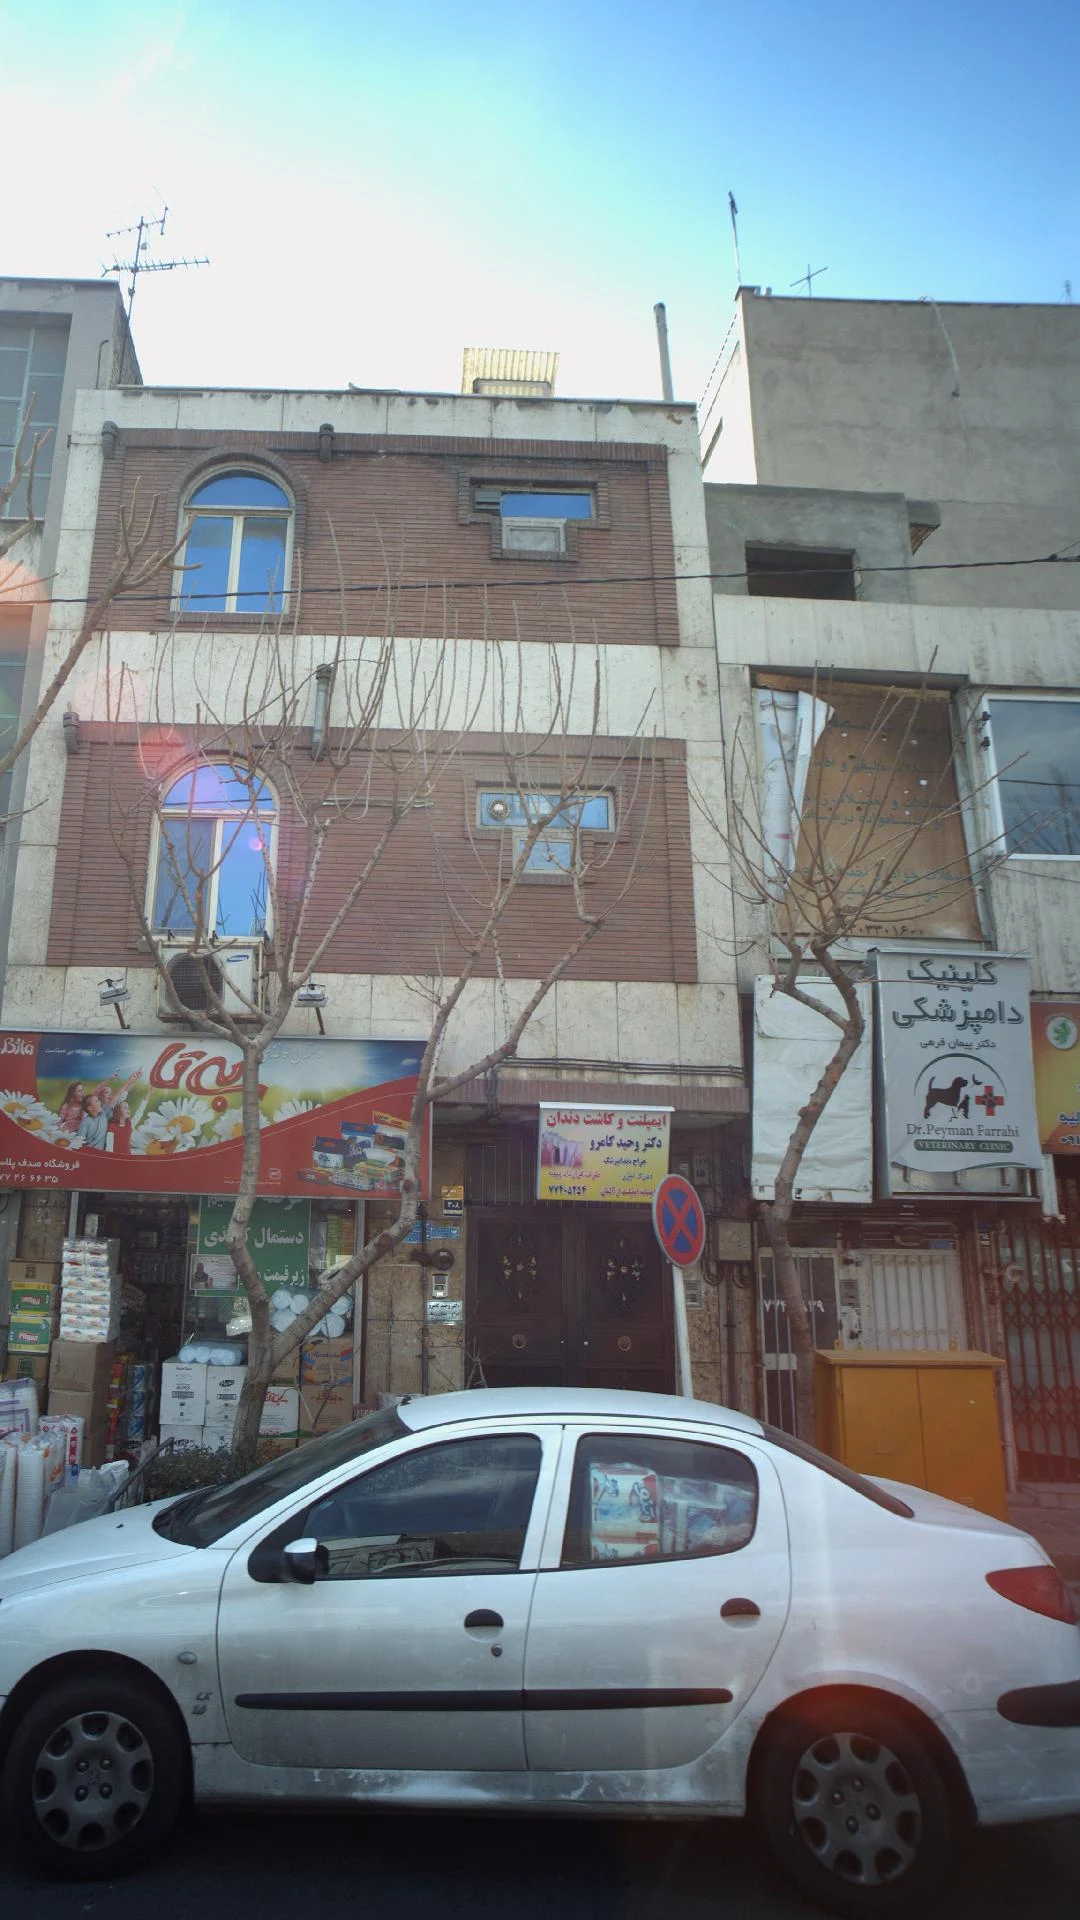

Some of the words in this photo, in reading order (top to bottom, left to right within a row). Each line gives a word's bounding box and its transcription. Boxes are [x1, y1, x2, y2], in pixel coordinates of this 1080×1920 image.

[907, 959, 998, 992] کلینیک
[892, 996, 1024, 1035] دامپزشکی
[947, 1039, 973, 1050] پیمان
[975, 1039, 996, 1050] دکتر
[546, 1110, 580, 1127] دندان
[583, 1111, 616, 1126] کاشت
[617, 1119, 624, 1130] و
[626, 1113, 667, 1131] ایمپلنت
[976, 1124, 1020, 1137] Farrahi
[616, 1136, 640, 1152] وحید
[641, 1136, 662, 1152] دکتر
[919, 1140, 977, 1150] VETERINARY
[980, 1142, 1011, 1151] CLINIC
[44, 1158, 80, 1171] فروشگاه
[254, 1226, 304, 1248] دستمال
[263, 1264, 289, 1285] قیمت
